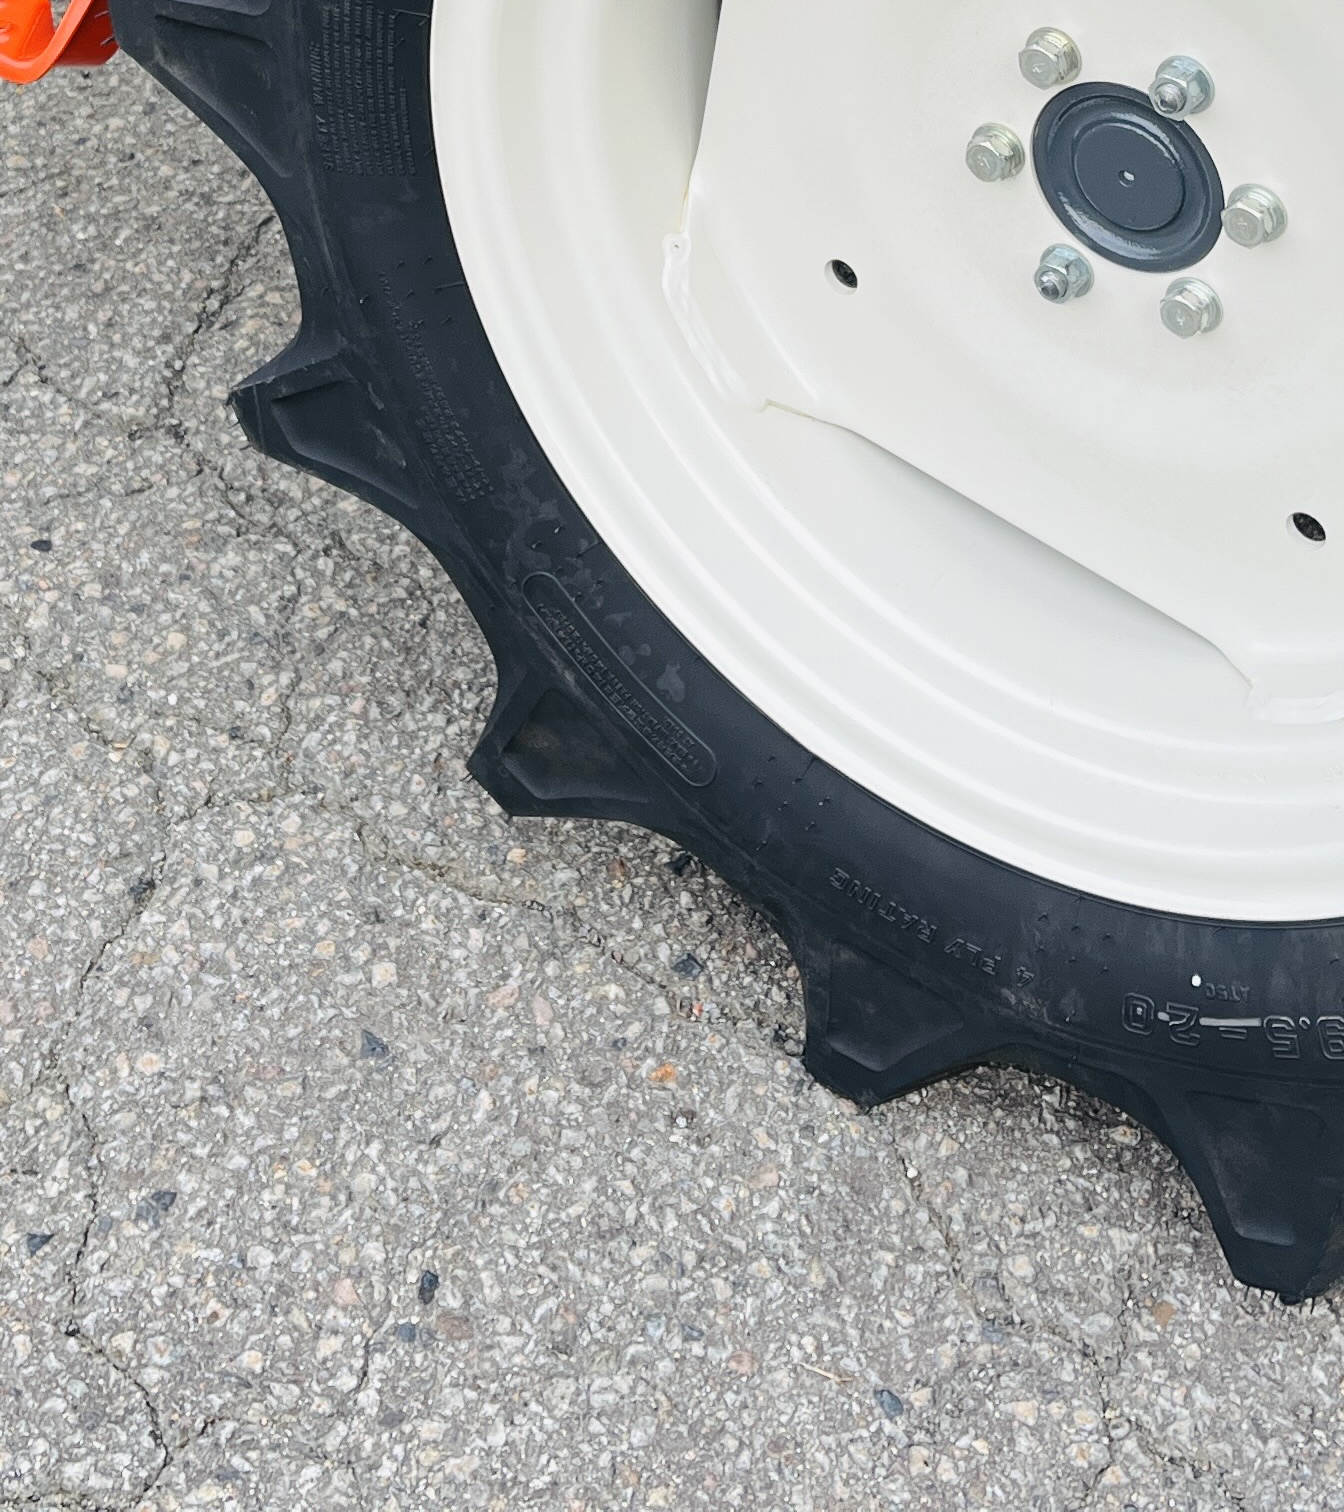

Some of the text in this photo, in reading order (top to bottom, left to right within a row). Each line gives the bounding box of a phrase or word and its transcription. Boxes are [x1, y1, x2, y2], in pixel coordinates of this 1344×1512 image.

[826, 865, 1036, 991] 4 PLY RATING
